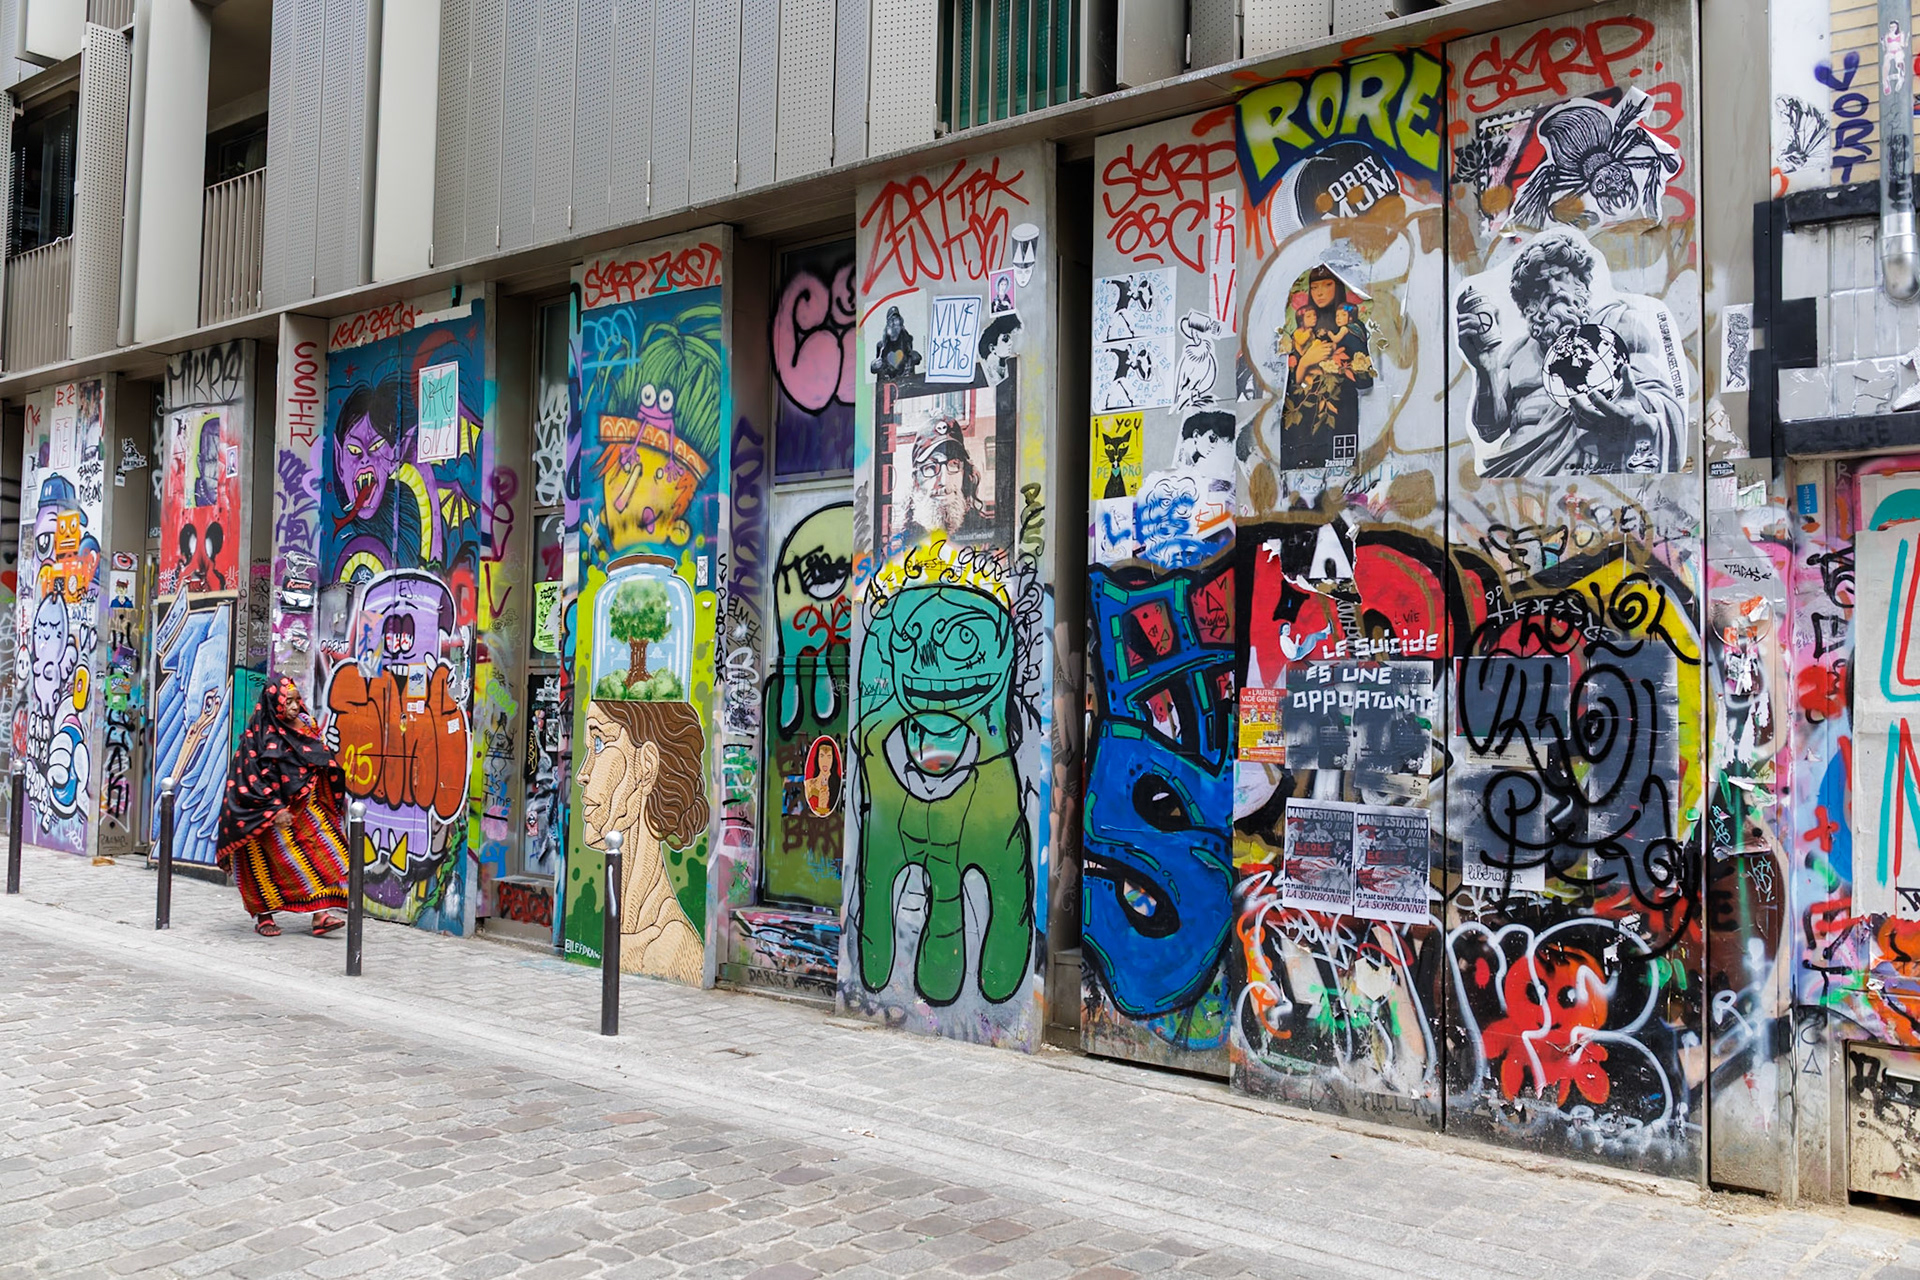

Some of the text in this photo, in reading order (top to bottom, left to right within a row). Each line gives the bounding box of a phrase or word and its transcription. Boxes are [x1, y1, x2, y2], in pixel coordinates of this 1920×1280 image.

[1236, 50, 1442, 182] RORE
[936, 303, 974, 336] VIVE
[932, 338, 970, 370] PEDRO
[1322, 640, 1348, 660] LE
[1342, 666, 1393, 685] UNE
[1287, 807, 1353, 822] MANIFESTATION
[1358, 815, 1428, 829] MANIFESTATION
[1323, 822, 1353, 831] 20 JUIN
[1395, 828, 1427, 838] 20 JUIN
[1286, 890, 1351, 905] LA SORBONNE
[1357, 900, 1427, 914] LA SORBONNE
